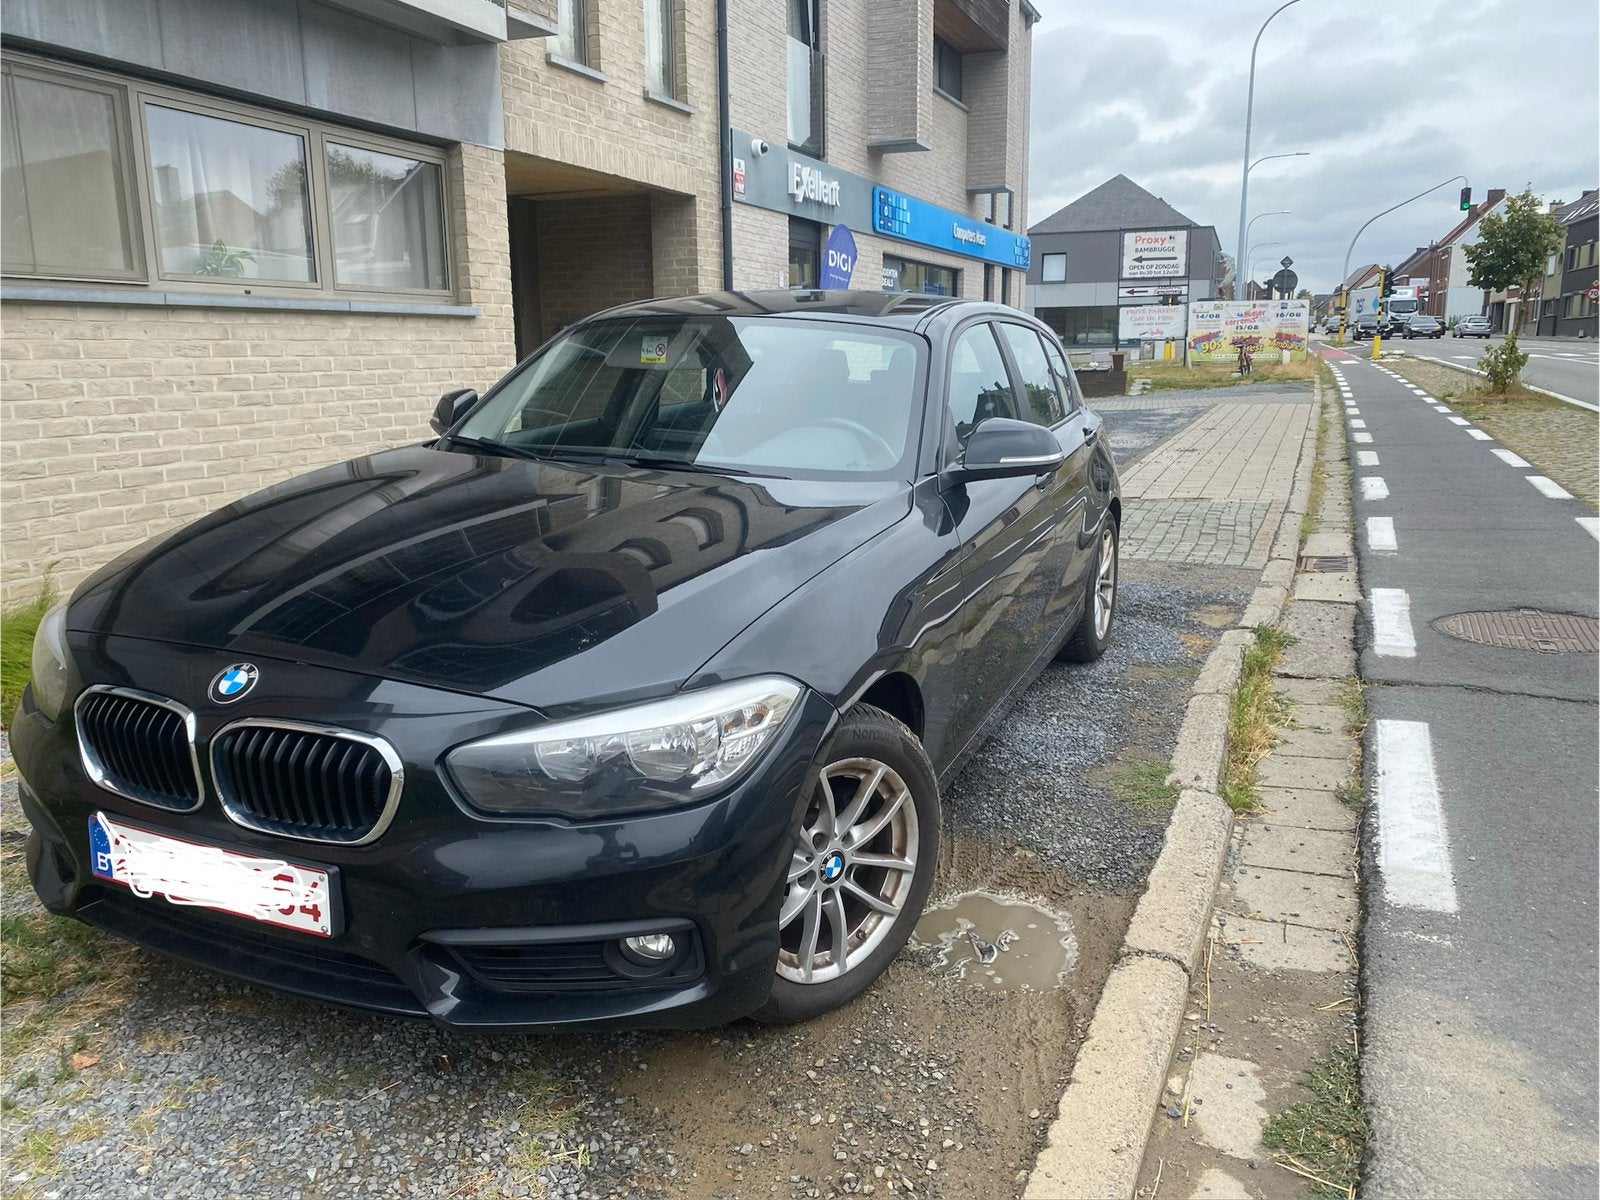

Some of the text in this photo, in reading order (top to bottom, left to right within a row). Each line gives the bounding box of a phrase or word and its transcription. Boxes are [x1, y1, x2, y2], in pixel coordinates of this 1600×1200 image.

[1135, 235, 1167, 246] Proxy
[828, 249, 851, 273] DIGI
[97, 851, 109, 871] B
